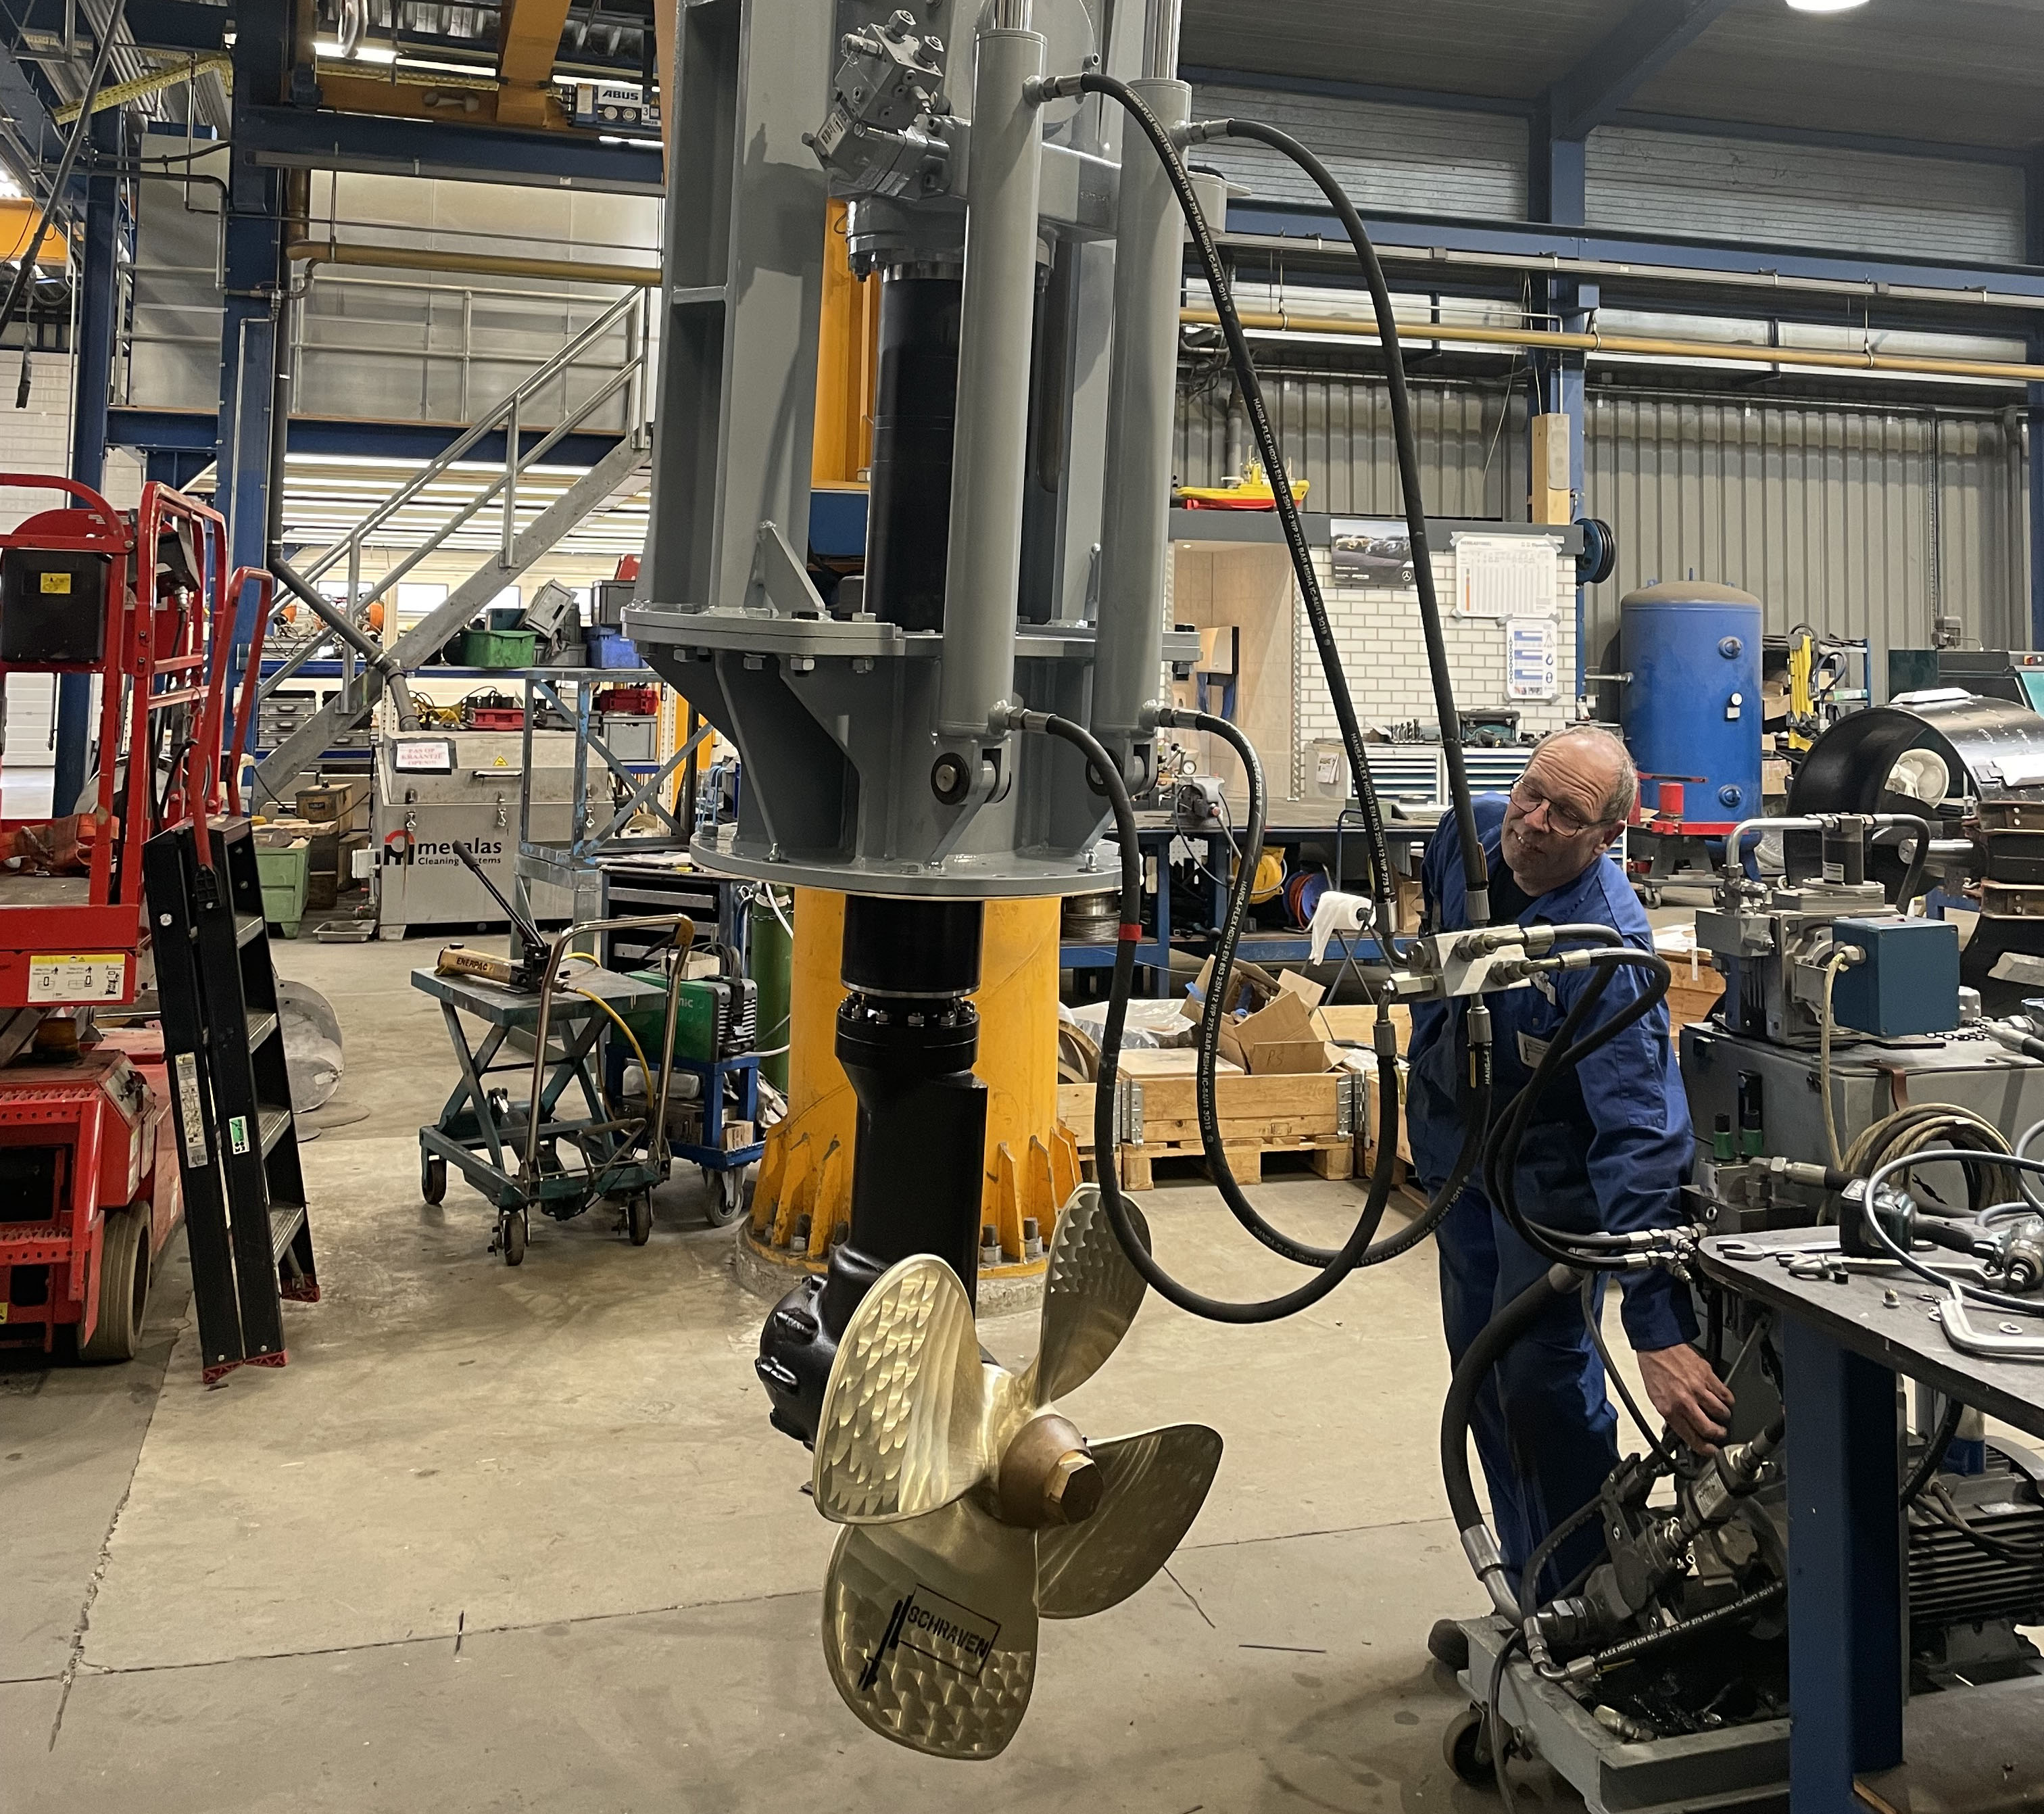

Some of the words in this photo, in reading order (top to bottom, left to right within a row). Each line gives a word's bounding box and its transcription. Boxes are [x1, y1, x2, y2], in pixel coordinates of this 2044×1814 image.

[602, 90, 639, 101] ABUS
[643, 107, 649, 116] 3
[1124, 89, 1157, 124] HANSA-FLEX
[1189, 202, 1200, 215] 275
[1195, 215, 1204, 231] BAR
[1200, 232, 1213, 254] MSHA
[1252, 398, 1273, 445] HANSA-FLEX
[1267, 445, 1280, 469] HD213
[1274, 469, 1283, 480] EN
[1278, 481, 1287, 494] 853
[1282, 495, 1292, 510] 2SN
[1287, 510, 1294, 520] 12
[1290, 520, 1298, 533] WP
[1294, 533, 1303, 546] 275
[1298, 547, 1308, 563] BAR
[1303, 564, 1314, 587] MSHA
[1350, 732, 1368, 781] HANSA-FLEX
[1363, 781, 1374, 805] HD213
[1369, 805, 1377, 817] EN
[1371, 817, 1380, 831] 853
[418, 838, 502, 855] mealas
[1375, 832, 1384, 847] 2SN
[1378, 849, 1385, 857] 12
[418, 857, 459, 866] Cleaning
[1380, 858, 1388, 872] WP
[1382, 872, 1390, 886] 275
[1230, 880, 1247, 926] HANSA-FLEX
[1224, 926, 1236, 949] HD213
[1221, 950, 1230, 962] EN
[456, 957, 488, 971] ENERPAC
[1218, 962, 1226, 975] 853
[1214, 976, 1223, 993] 2SN
[1212, 994, 1219, 1003] 12
[1210, 1003, 1217, 1017] WP
[1207, 1017, 1215, 1031] 275
[1204, 1032, 1213, 1050] BAR
[1647, 1633, 1659, 1641] 853
[1691, 1617, 1703, 1625] 275
[1703, 1612, 1717, 1620] BAR
[1717, 1604, 1735, 1616] MSHA
[907, 1605, 990, 1658] SCHRAVEN
